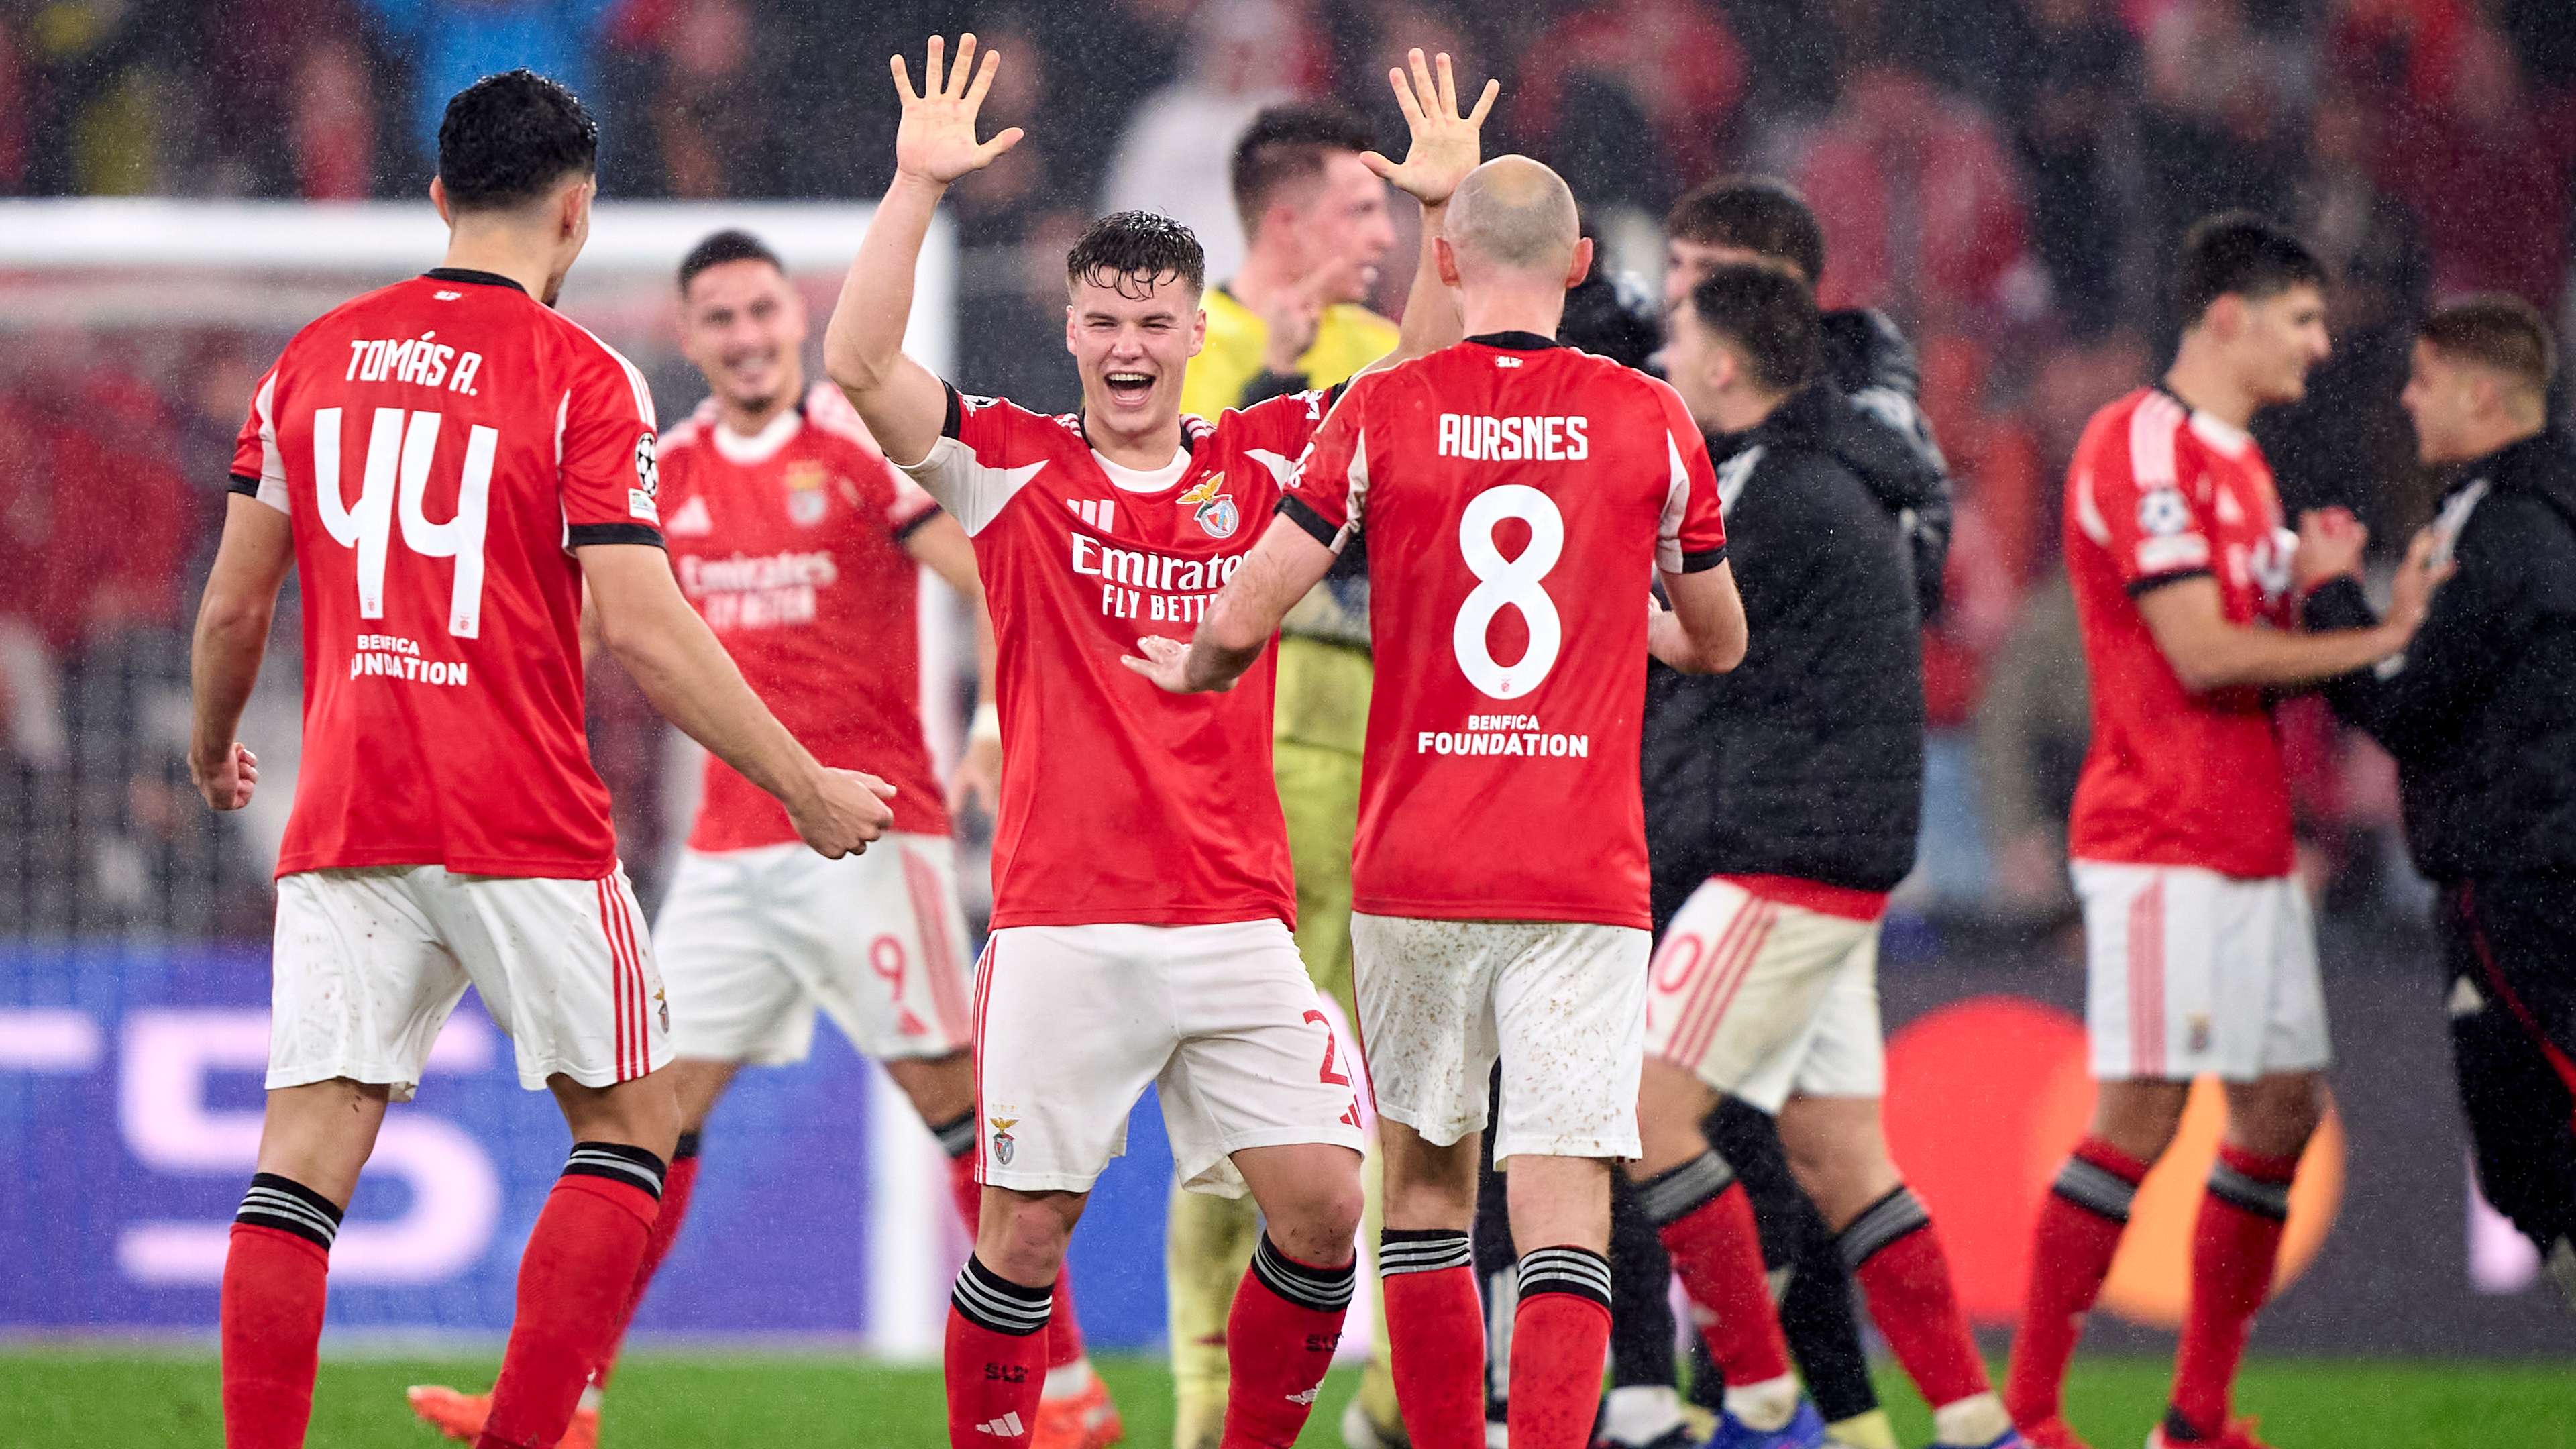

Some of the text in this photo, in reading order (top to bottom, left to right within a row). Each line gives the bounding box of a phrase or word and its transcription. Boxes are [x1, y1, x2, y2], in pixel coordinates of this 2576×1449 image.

[345, 331, 482, 396] TOMÁS A.
[1438, 413, 1588, 462] AURSNES
[313, 407, 498, 639] 44
[1102, 583, 1140, 619] FLY
[1453, 484, 1564, 700] 8
[1418, 731, 1589, 758] FOUNDATION
[1468, 714, 1540, 731] BENFICA
[870, 934, 905, 1001] 9
[1302, 1009, 1350, 1087] 2
